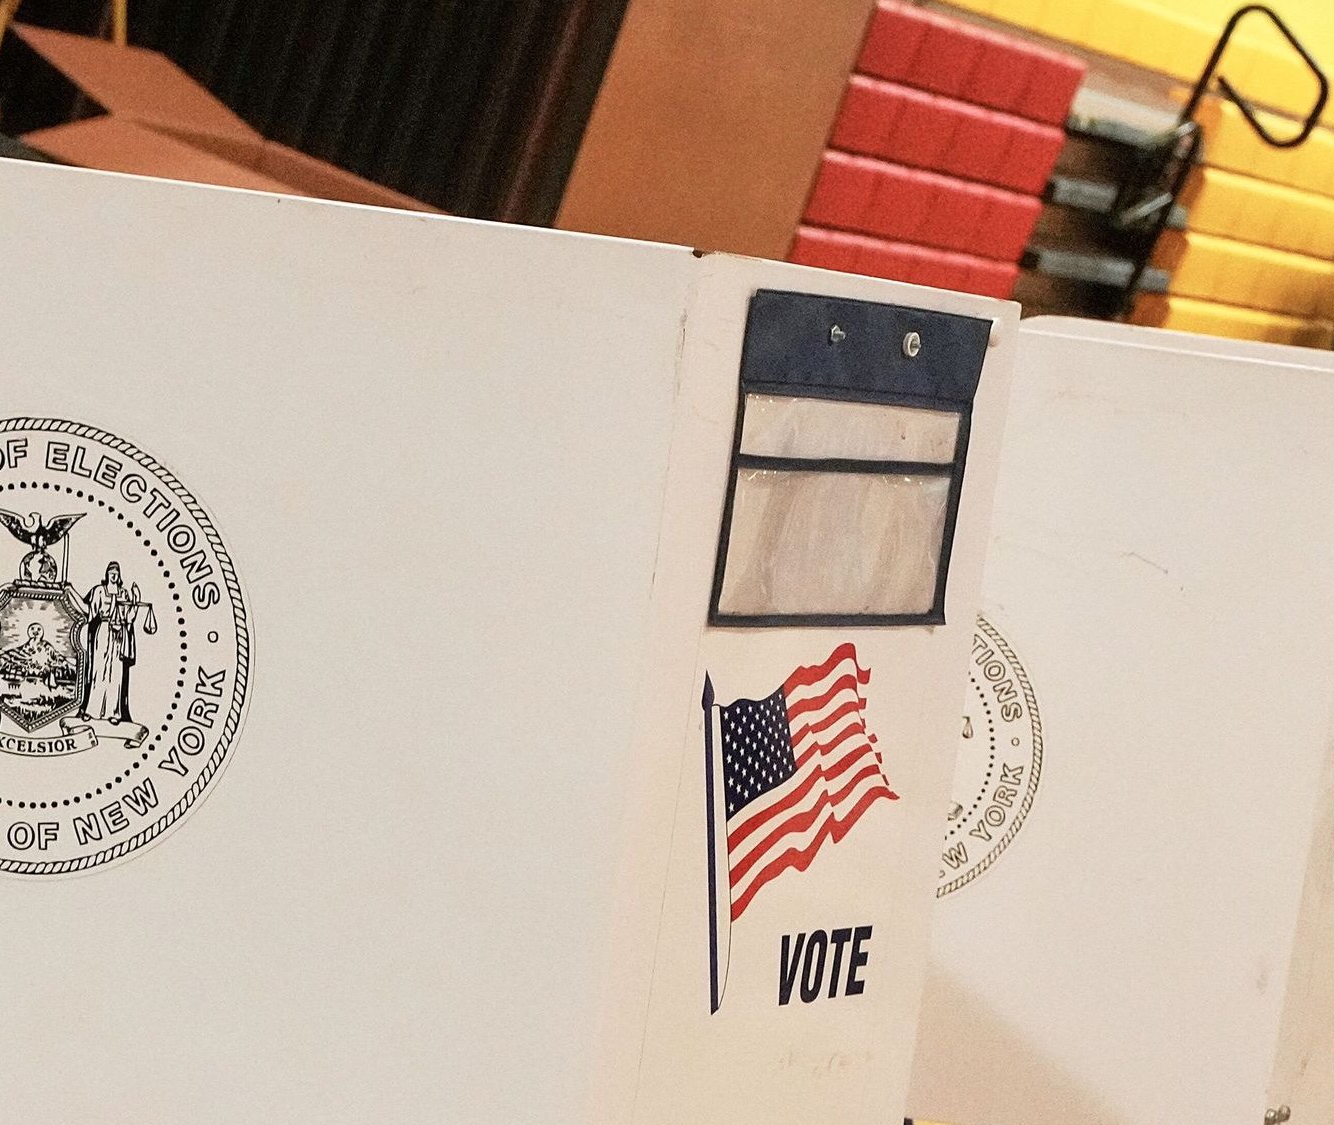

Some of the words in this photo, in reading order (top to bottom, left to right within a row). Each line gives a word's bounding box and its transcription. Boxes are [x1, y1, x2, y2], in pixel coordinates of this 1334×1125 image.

[46, 442, 220, 610] ELECTIONS
[7, 822, 59, 850] OF
[73, 778, 159, 846] NEW
[158, 666, 227, 780] YORK
[969, 763, 1025, 843] YORK
[779, 925, 873, 1006] VOTE
